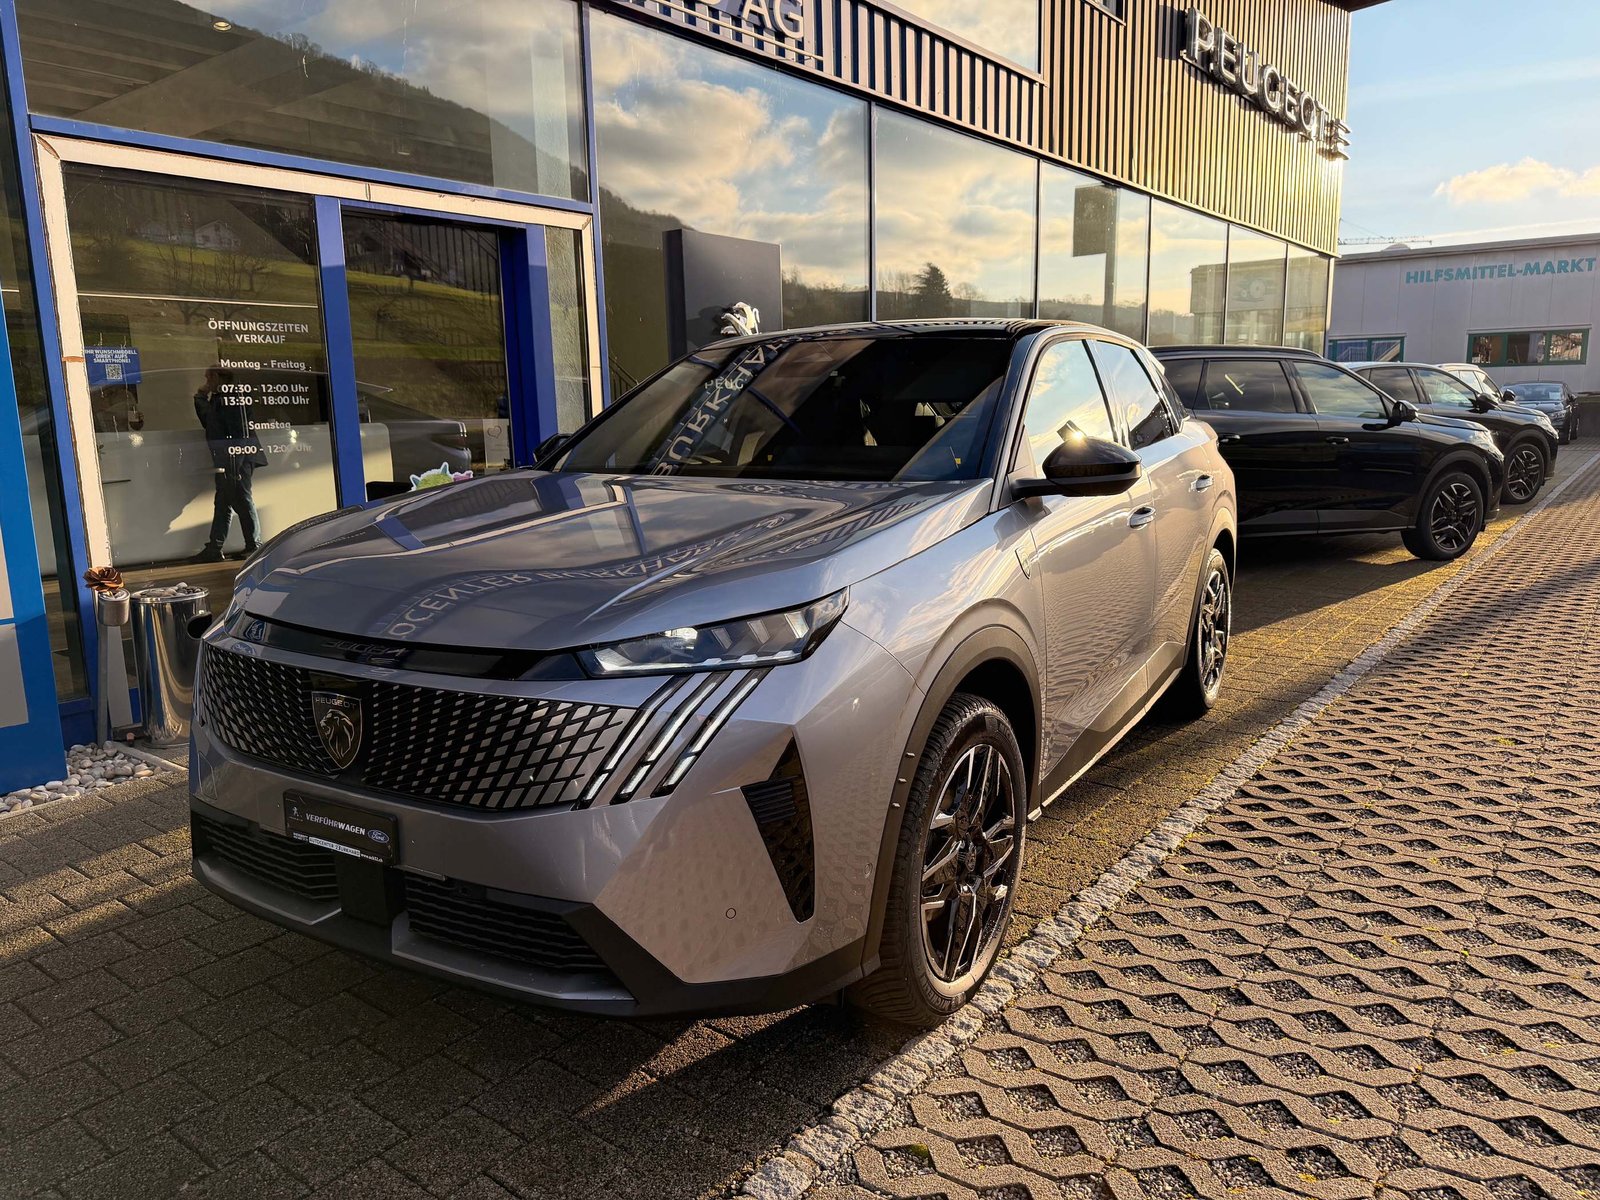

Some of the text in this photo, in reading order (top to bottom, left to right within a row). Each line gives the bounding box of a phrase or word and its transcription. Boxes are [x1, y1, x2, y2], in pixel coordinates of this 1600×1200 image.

[741, 0, 804, 39] AG
[1186, 7, 1330, 143] PEUGEOT
[1405, 257, 1597, 284] HILFSMITTEL-MARKT
[208, 317, 309, 333] ÖFFNUNGSZEITEN
[235, 334, 286, 344] VERKAUF
[220, 359, 260, 370] Montag
[270, 360, 306, 371] Freitag
[221, 384, 252, 393] 07:30
[261, 384, 288, 393] 12:00
[291, 384, 309, 392] Uhr
[223, 396, 253, 406] 13:30
[262, 396, 290, 405] 18:00
[292, 395, 310, 405] Uhr
[248, 420, 291, 431] Samstag
[228, 445, 257, 455] 09:00
[314, 696, 357, 710] PEUGEOT
[305, 812, 366, 836] VERFÜHRWAGEN
[369, 830, 388, 842] Ford
